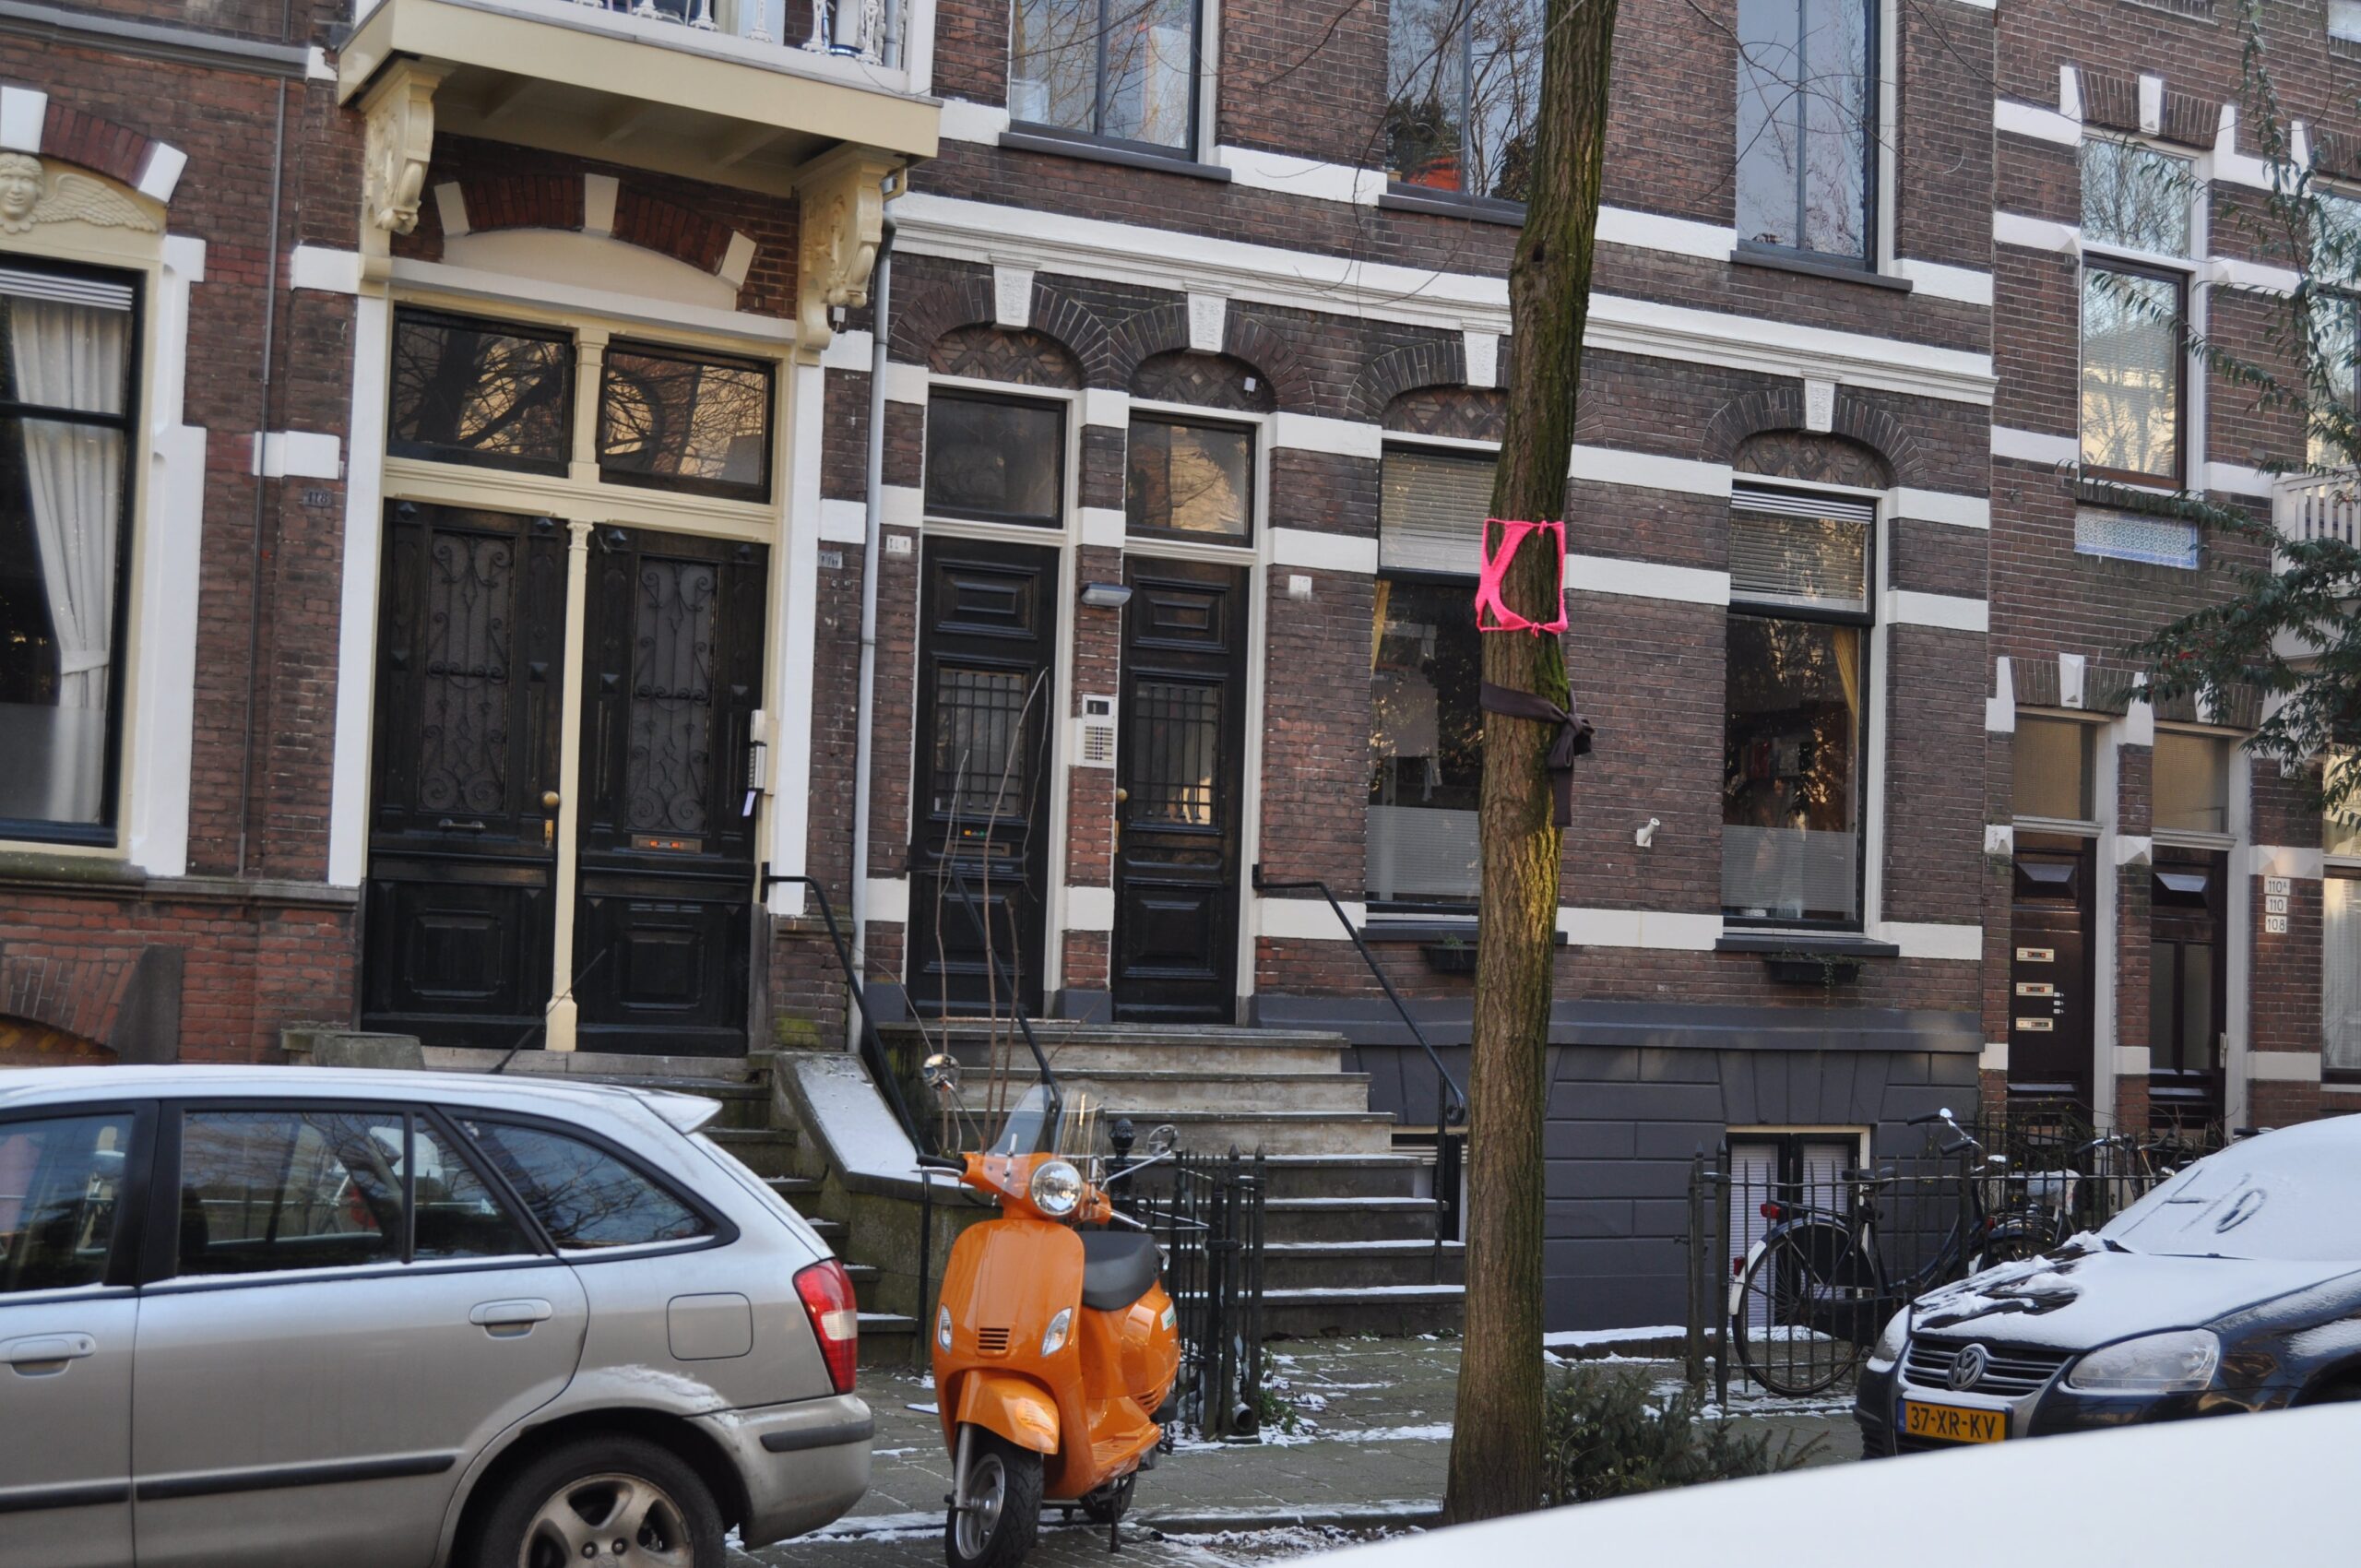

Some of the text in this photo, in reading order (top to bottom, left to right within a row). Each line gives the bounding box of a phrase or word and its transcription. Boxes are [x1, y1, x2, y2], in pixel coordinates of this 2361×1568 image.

[2270, 898, 2284, 911] 110
[2268, 919, 2284, 932] 108
[1911, 1406, 1996, 1440] 37-XR-KV
